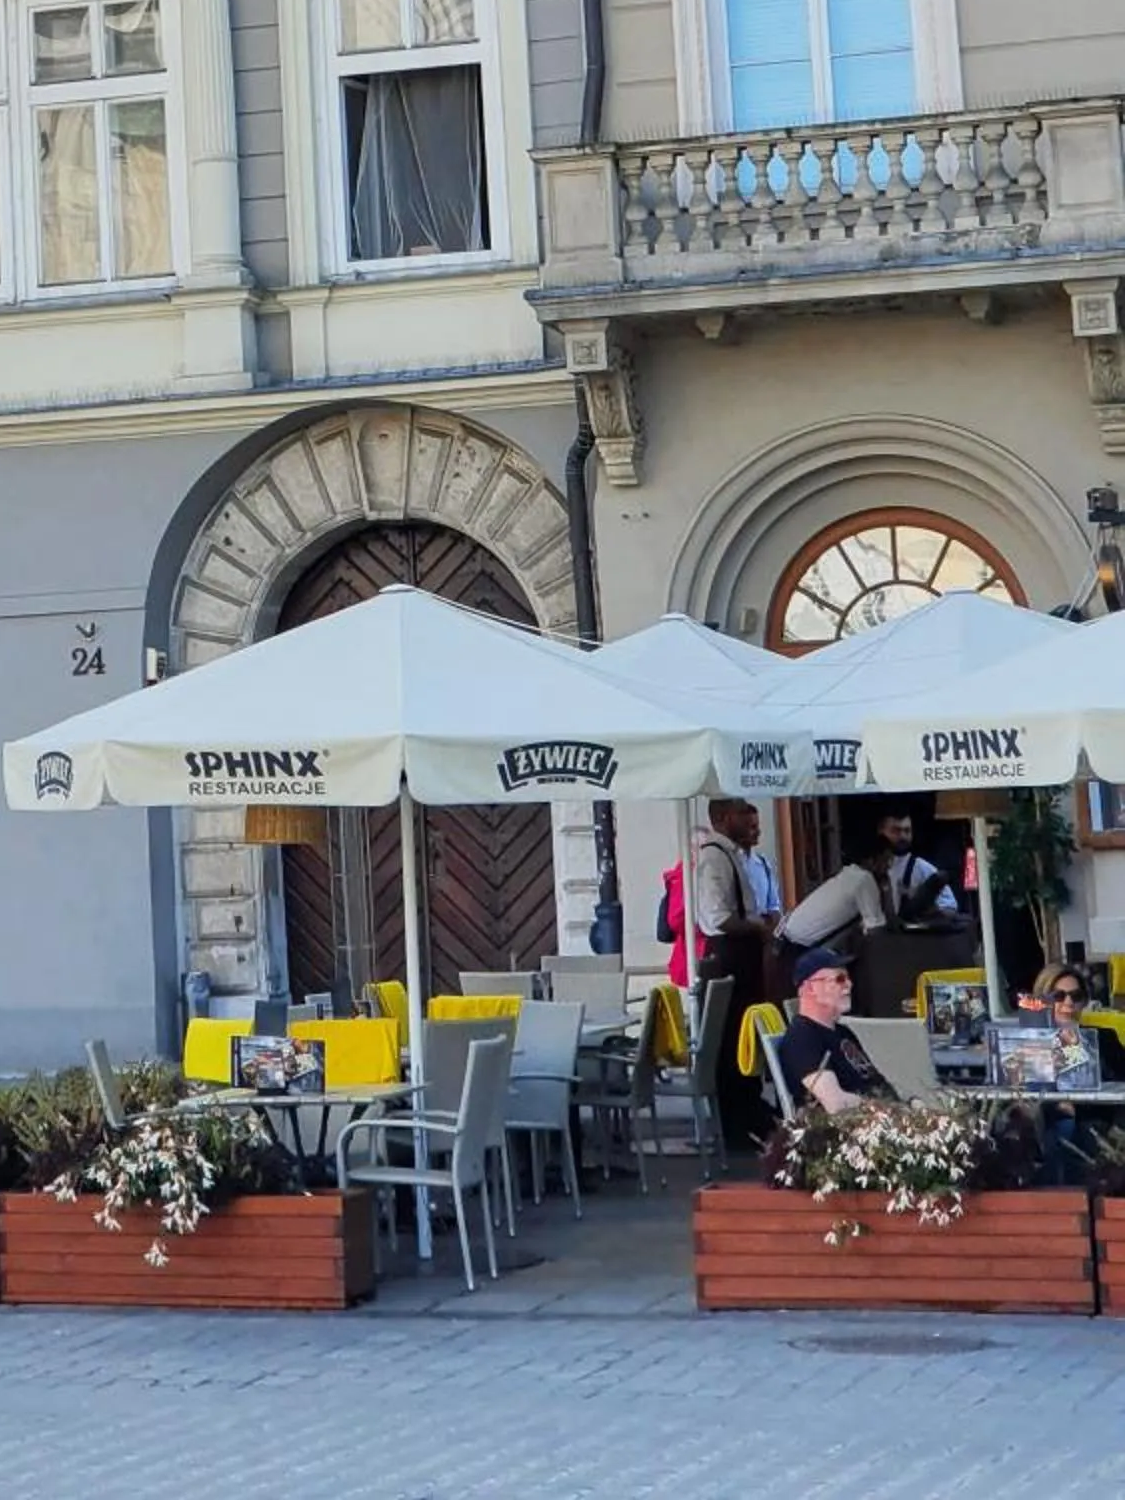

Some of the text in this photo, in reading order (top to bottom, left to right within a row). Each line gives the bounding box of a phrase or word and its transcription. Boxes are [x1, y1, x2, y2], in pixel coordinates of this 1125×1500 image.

[72, 646, 106, 676] 24
[740, 741, 787, 770] SPHINX
[921, 728, 1023, 762] SPHINX
[184, 751, 324, 778] SPHINX
[923, 763, 1026, 781] RESTAURACJE
[188, 781, 326, 796] RESTAURACJE
